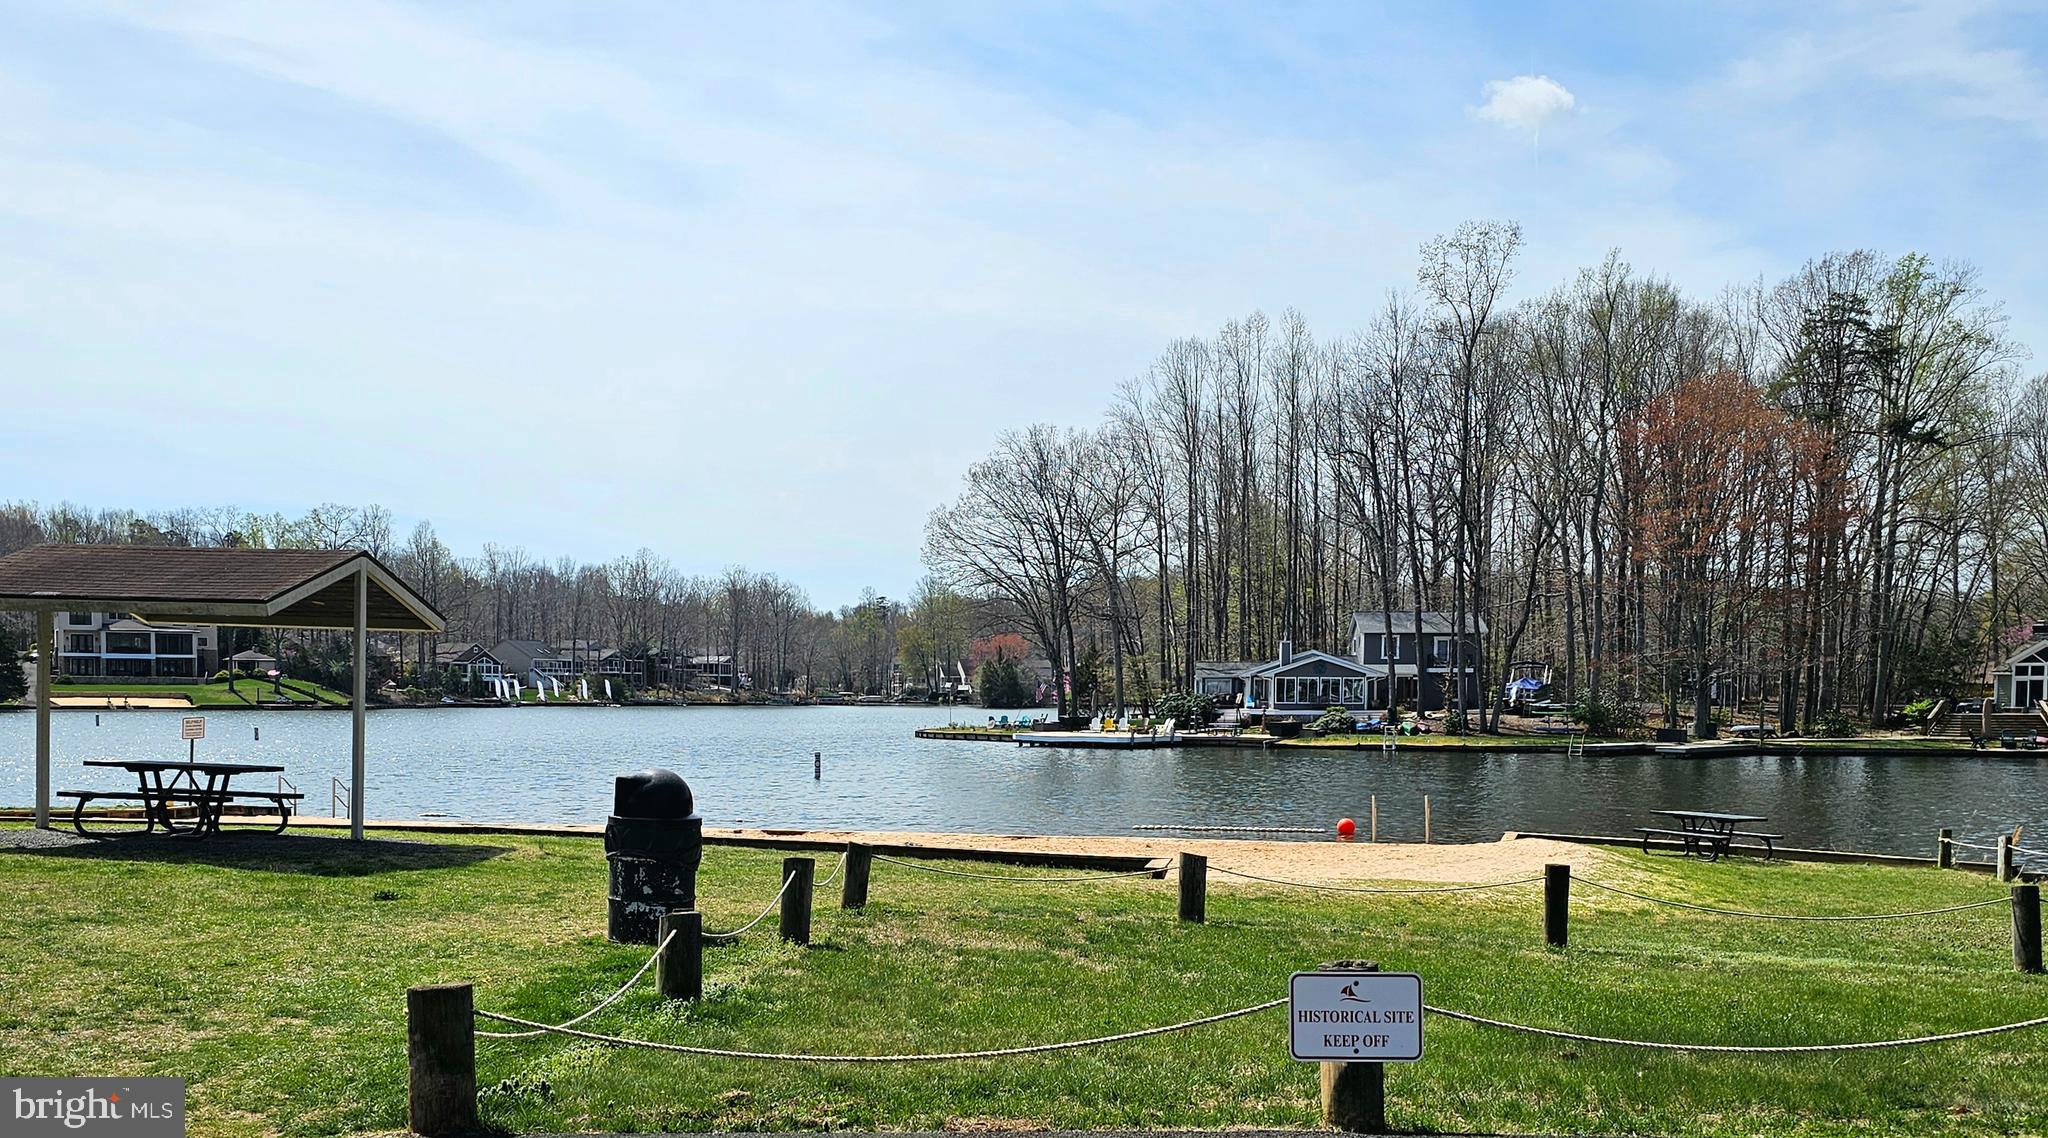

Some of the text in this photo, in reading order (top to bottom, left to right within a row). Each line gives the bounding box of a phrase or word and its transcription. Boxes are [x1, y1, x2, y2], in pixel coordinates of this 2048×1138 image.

[1298, 1010, 1415, 1024] HISTORICAL SITE
[1323, 1034, 1390, 1048] KEEP OFF
